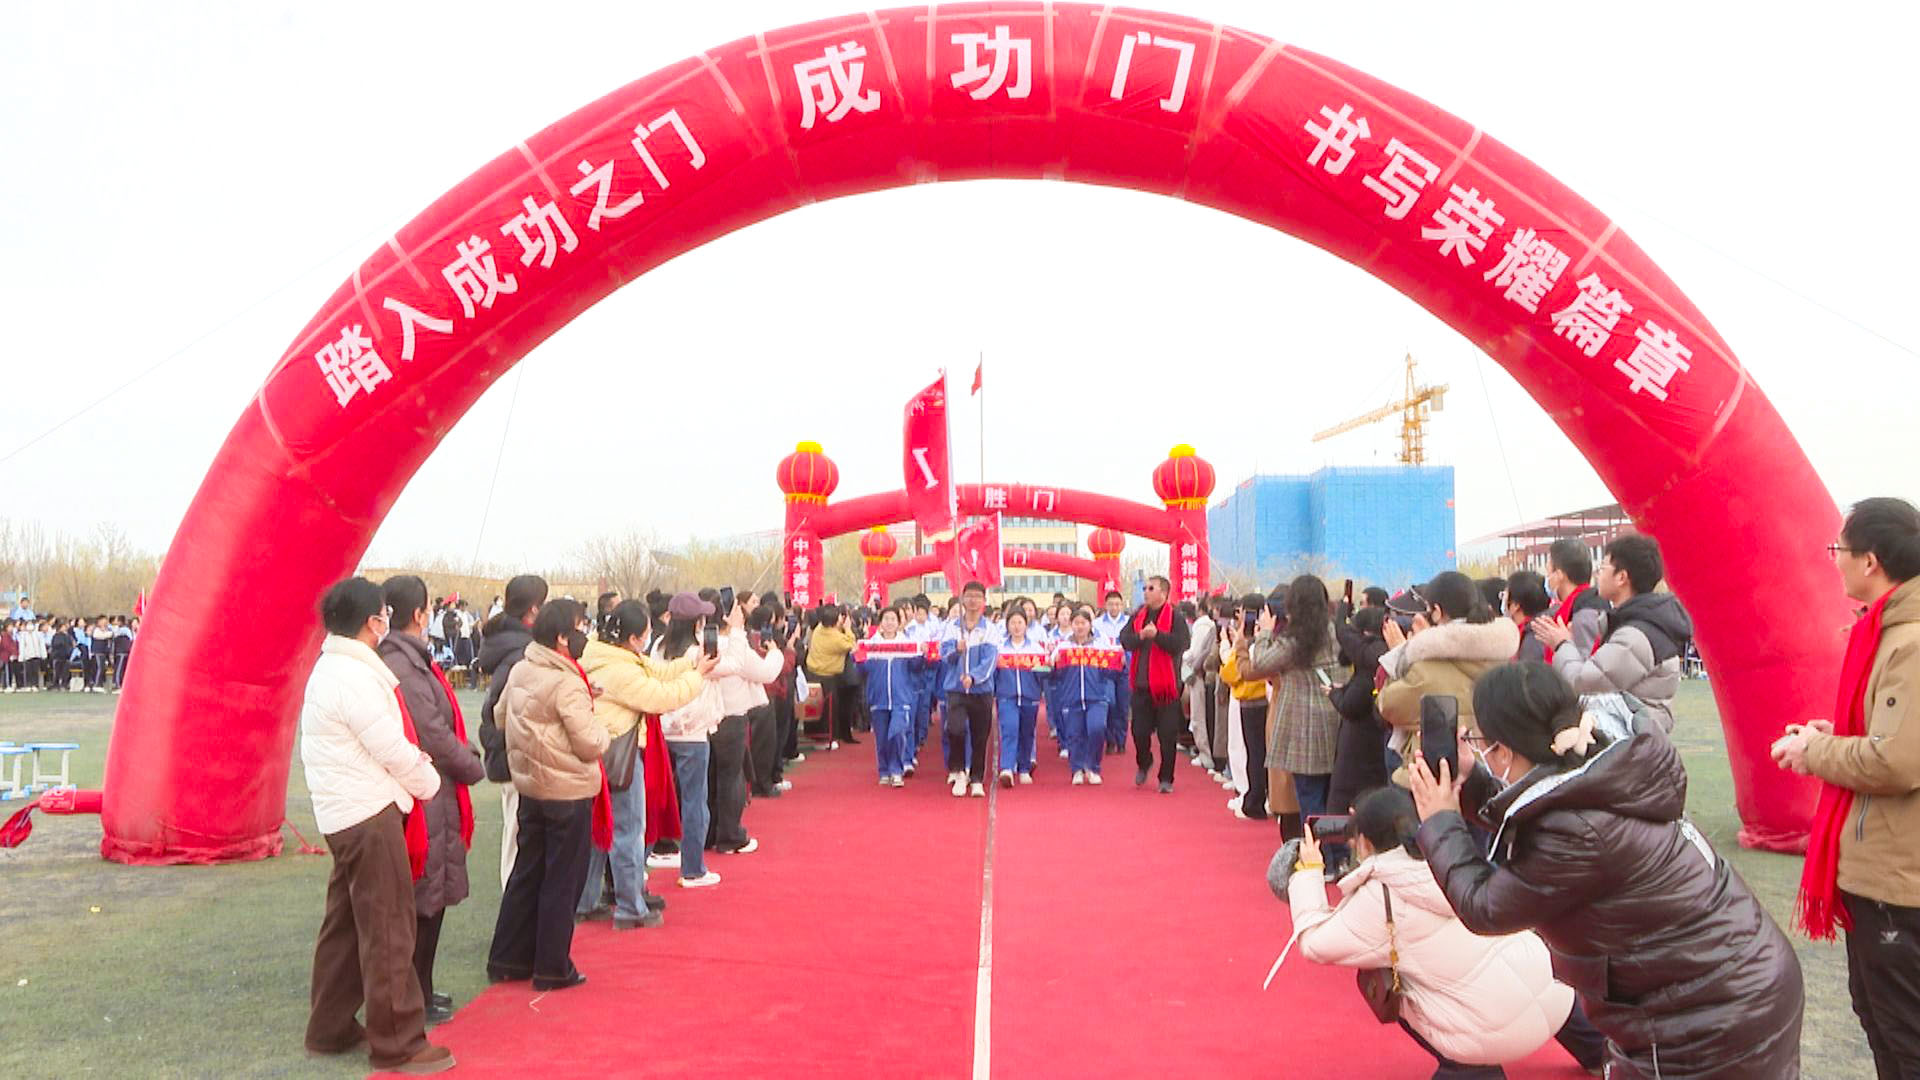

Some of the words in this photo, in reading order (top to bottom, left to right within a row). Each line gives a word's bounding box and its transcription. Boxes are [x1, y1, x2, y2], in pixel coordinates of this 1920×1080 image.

[792, 25, 1196, 128] 成功门
[314, 108, 706, 407] 踏入成功之门
[1303, 103, 1693, 401] 书写荣耀篇章
